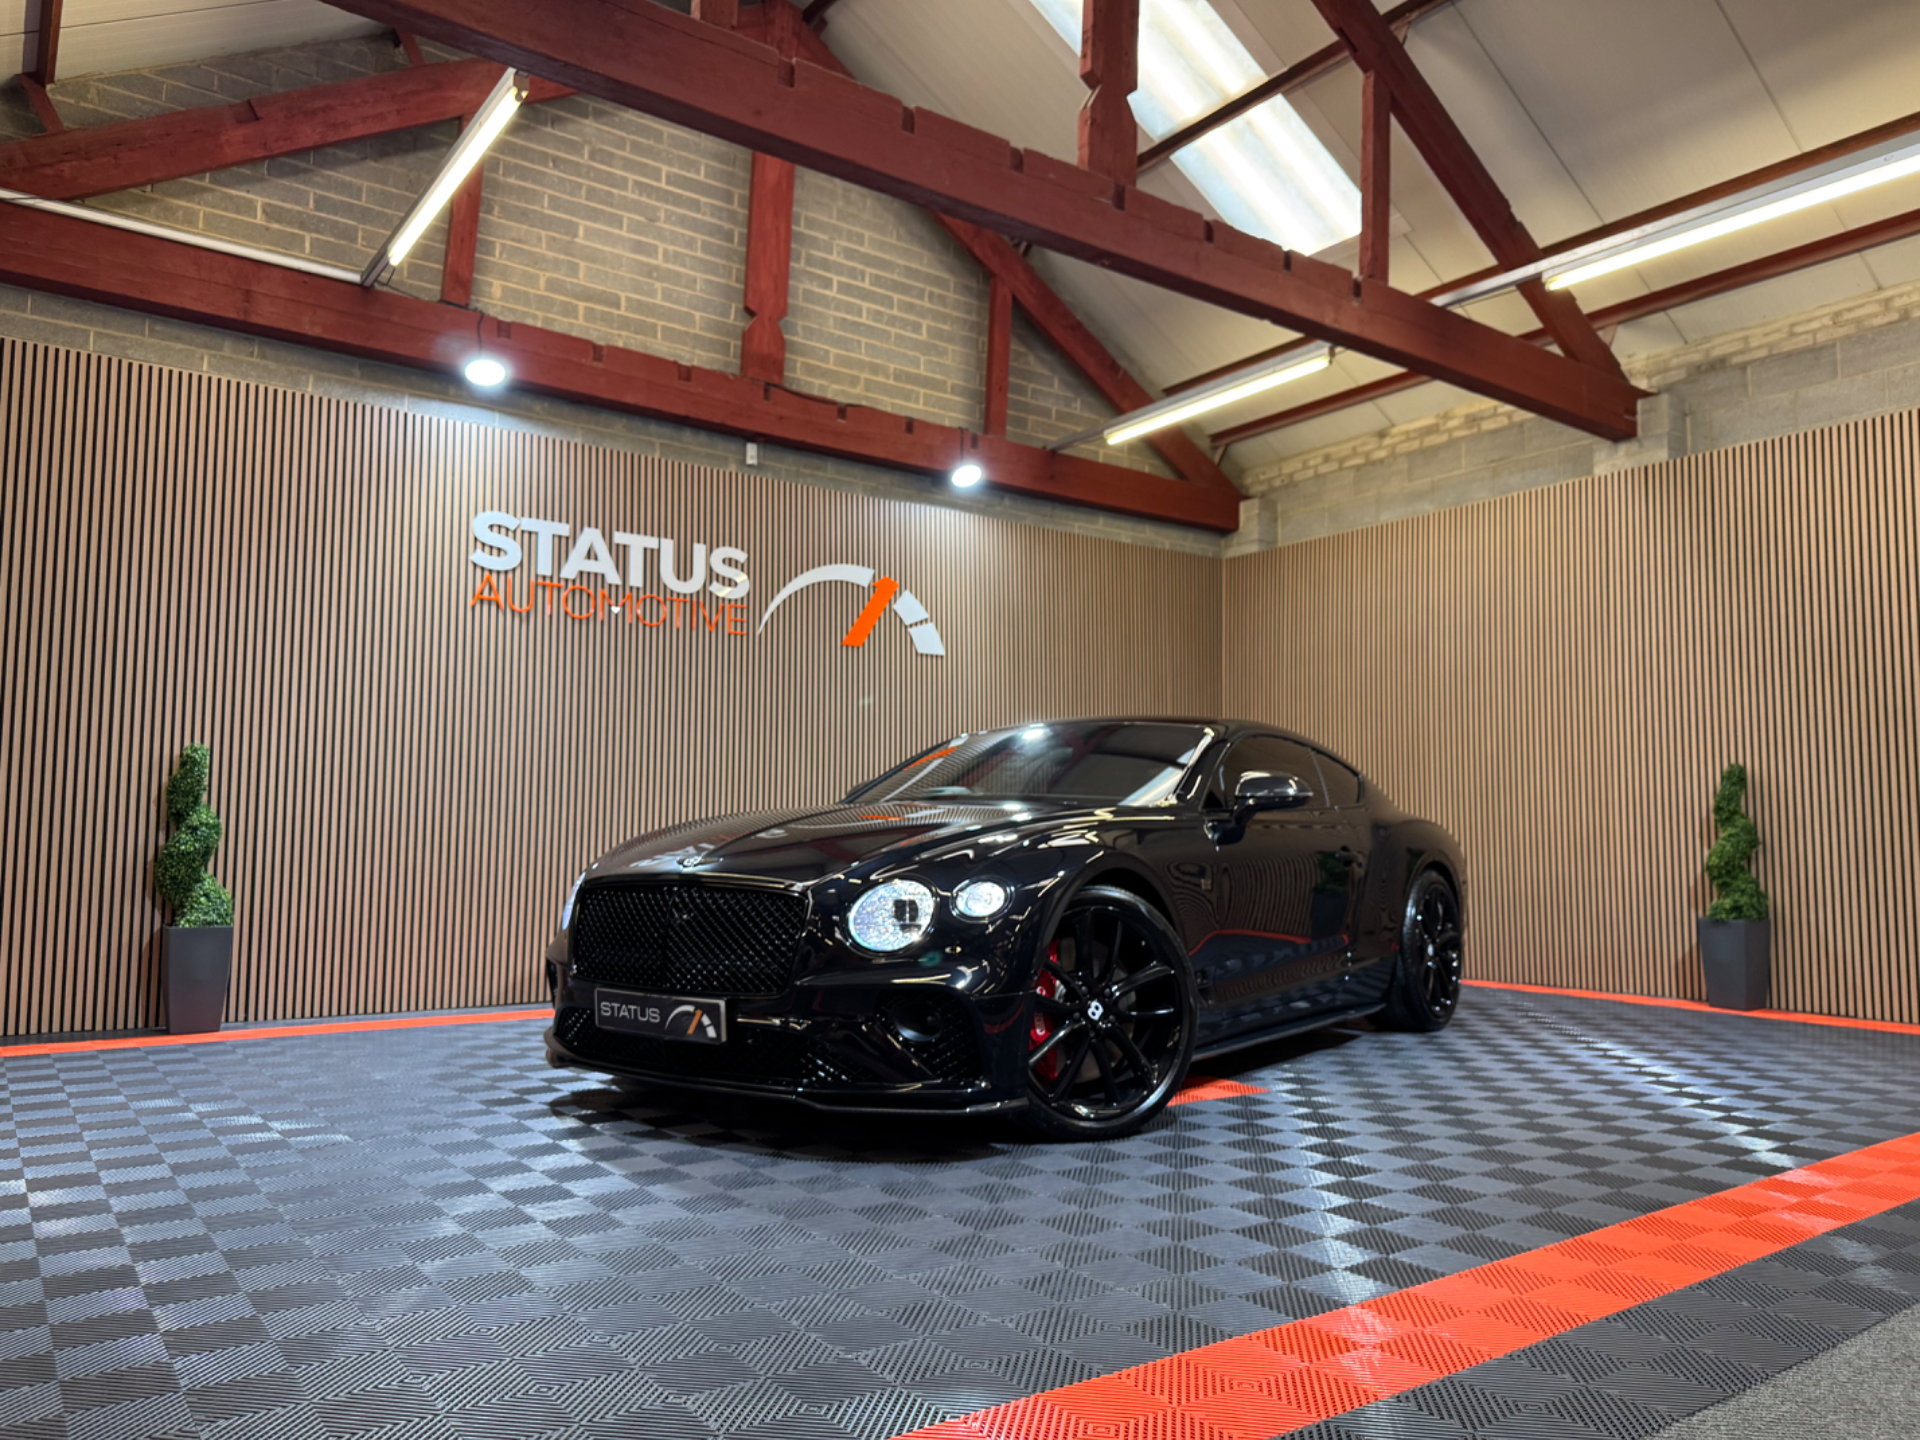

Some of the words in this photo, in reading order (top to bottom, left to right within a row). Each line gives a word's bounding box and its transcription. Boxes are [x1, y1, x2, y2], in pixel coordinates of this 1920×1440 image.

[470, 510, 750, 599] STATUS
[470, 574, 747, 636] AUTOMOTIVE
[600, 1001, 661, 1023] STATUS
